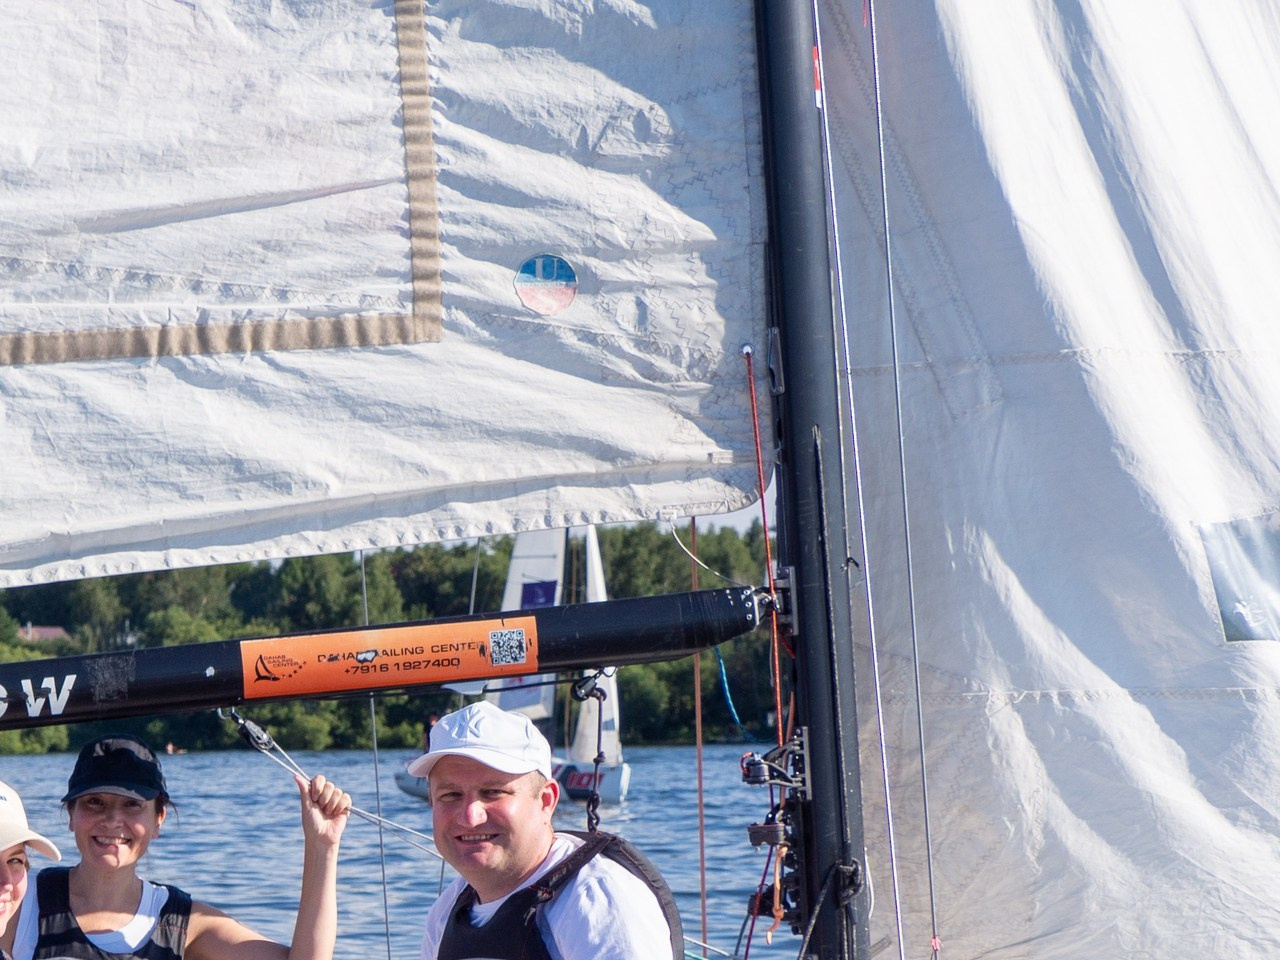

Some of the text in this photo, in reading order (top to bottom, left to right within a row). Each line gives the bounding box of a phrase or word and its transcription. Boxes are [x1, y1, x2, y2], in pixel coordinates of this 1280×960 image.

[370, 646, 424, 657] AILING
[344, 657, 461, 675] +7916 1927400
